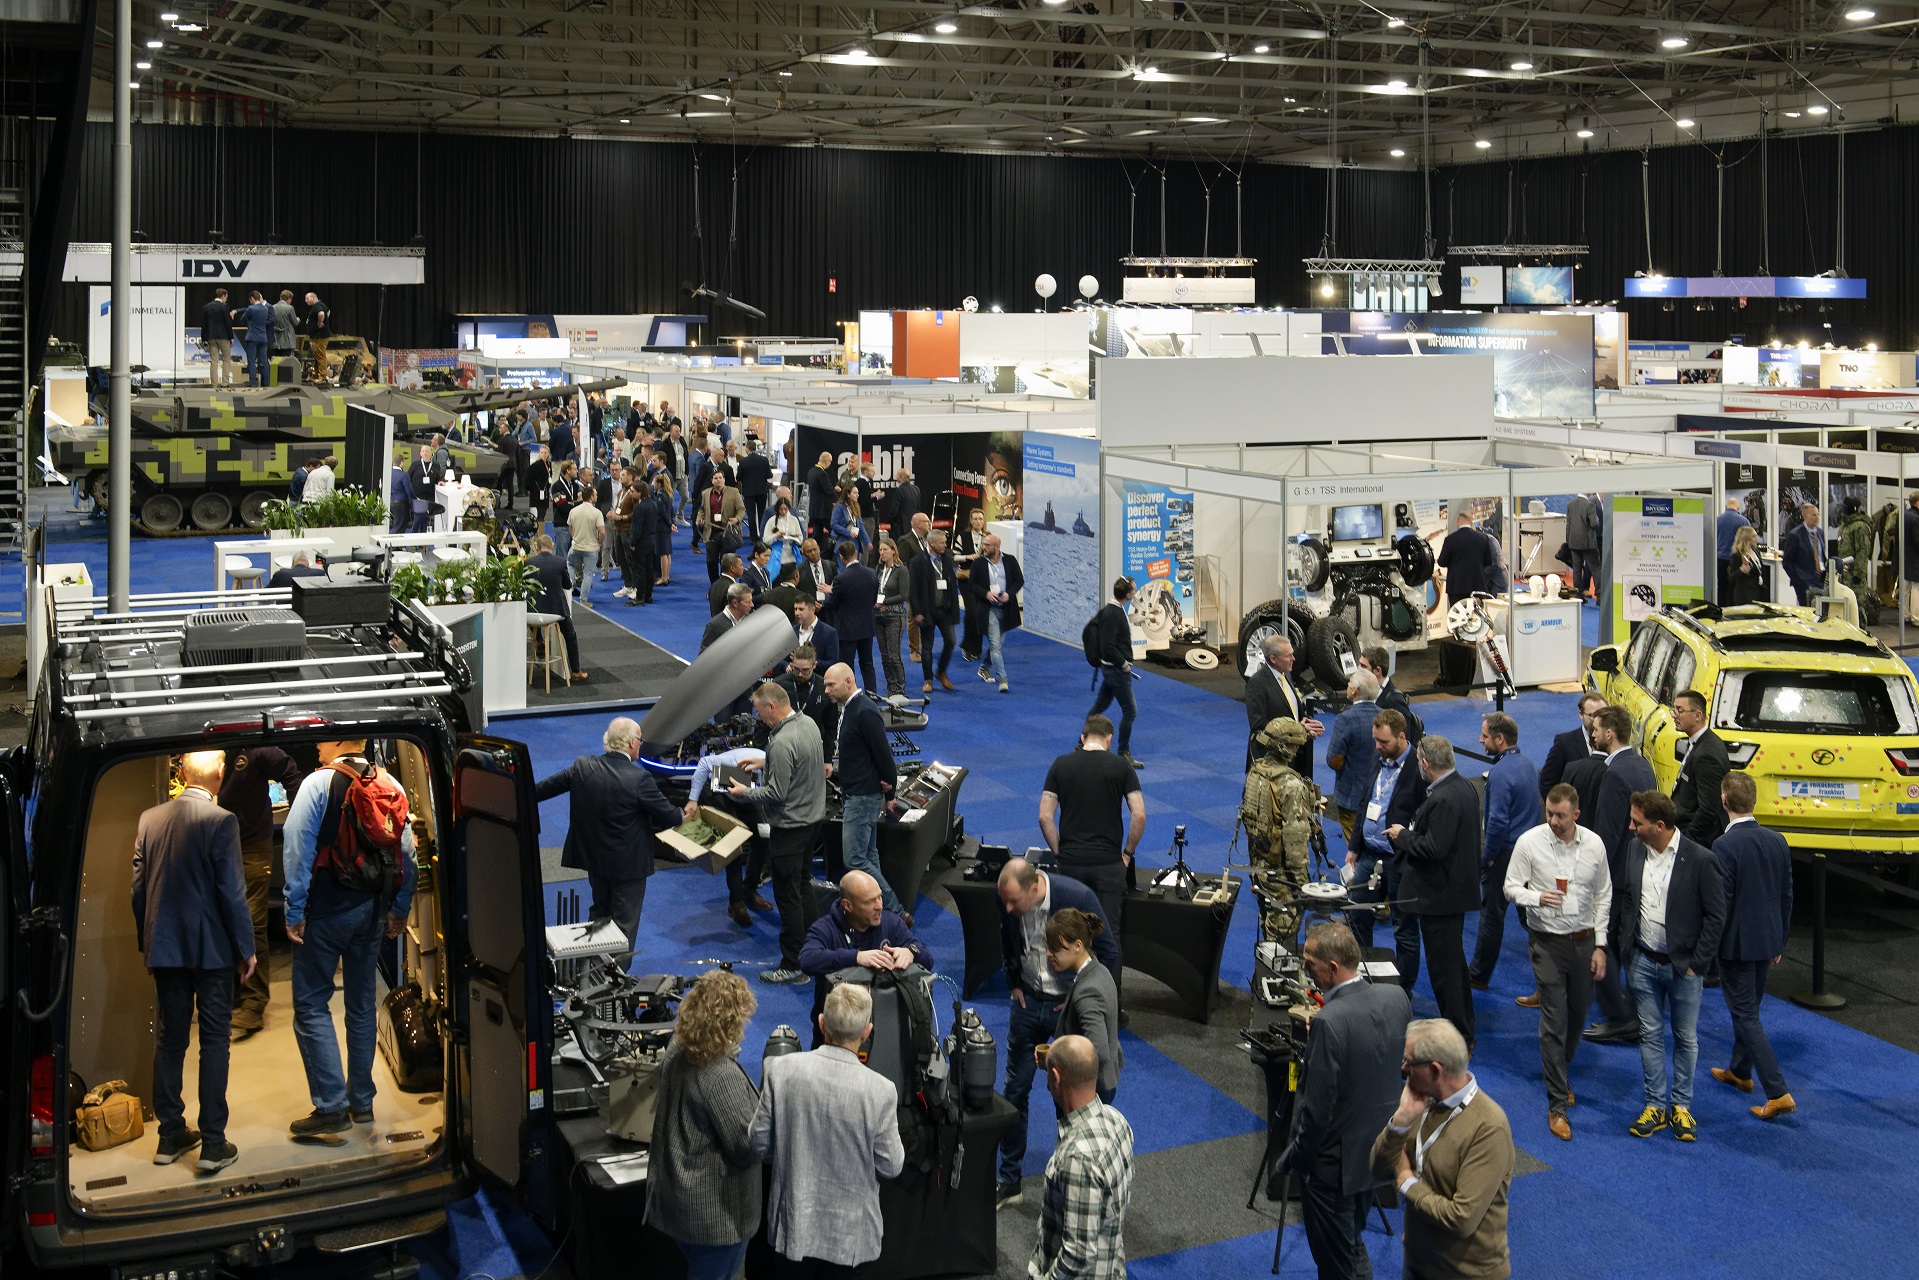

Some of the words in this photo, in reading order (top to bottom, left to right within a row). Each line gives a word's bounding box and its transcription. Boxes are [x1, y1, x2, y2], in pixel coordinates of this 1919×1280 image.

[182, 259, 250, 277] IDV
[1428, 335, 1477, 349] INFORMATION
[1478, 337, 1528, 350] SUPERIORITY
[1839, 364, 1859, 373] TNO
[1780, 400, 1831, 411] CHORA
[1867, 401, 1914, 411] CHORA
[1514, 428, 1536, 437] SYSTEMS
[1808, 454, 1849, 466] CARINTHIA
[954, 467, 974, 485] Connecting
[1294, 487, 1301, 496] G
[1304, 487, 1316, 495] 5.1
[1320, 486, 1336, 495] TSS
[1340, 485, 1384, 494] International
[1127, 492, 1165, 505] Discover
[1127, 504, 1159, 518] perfect
[1127, 517, 1162, 531] product
[1127, 530, 1162, 544] synergy
[1540, 618, 1563, 627] ARMOUR
